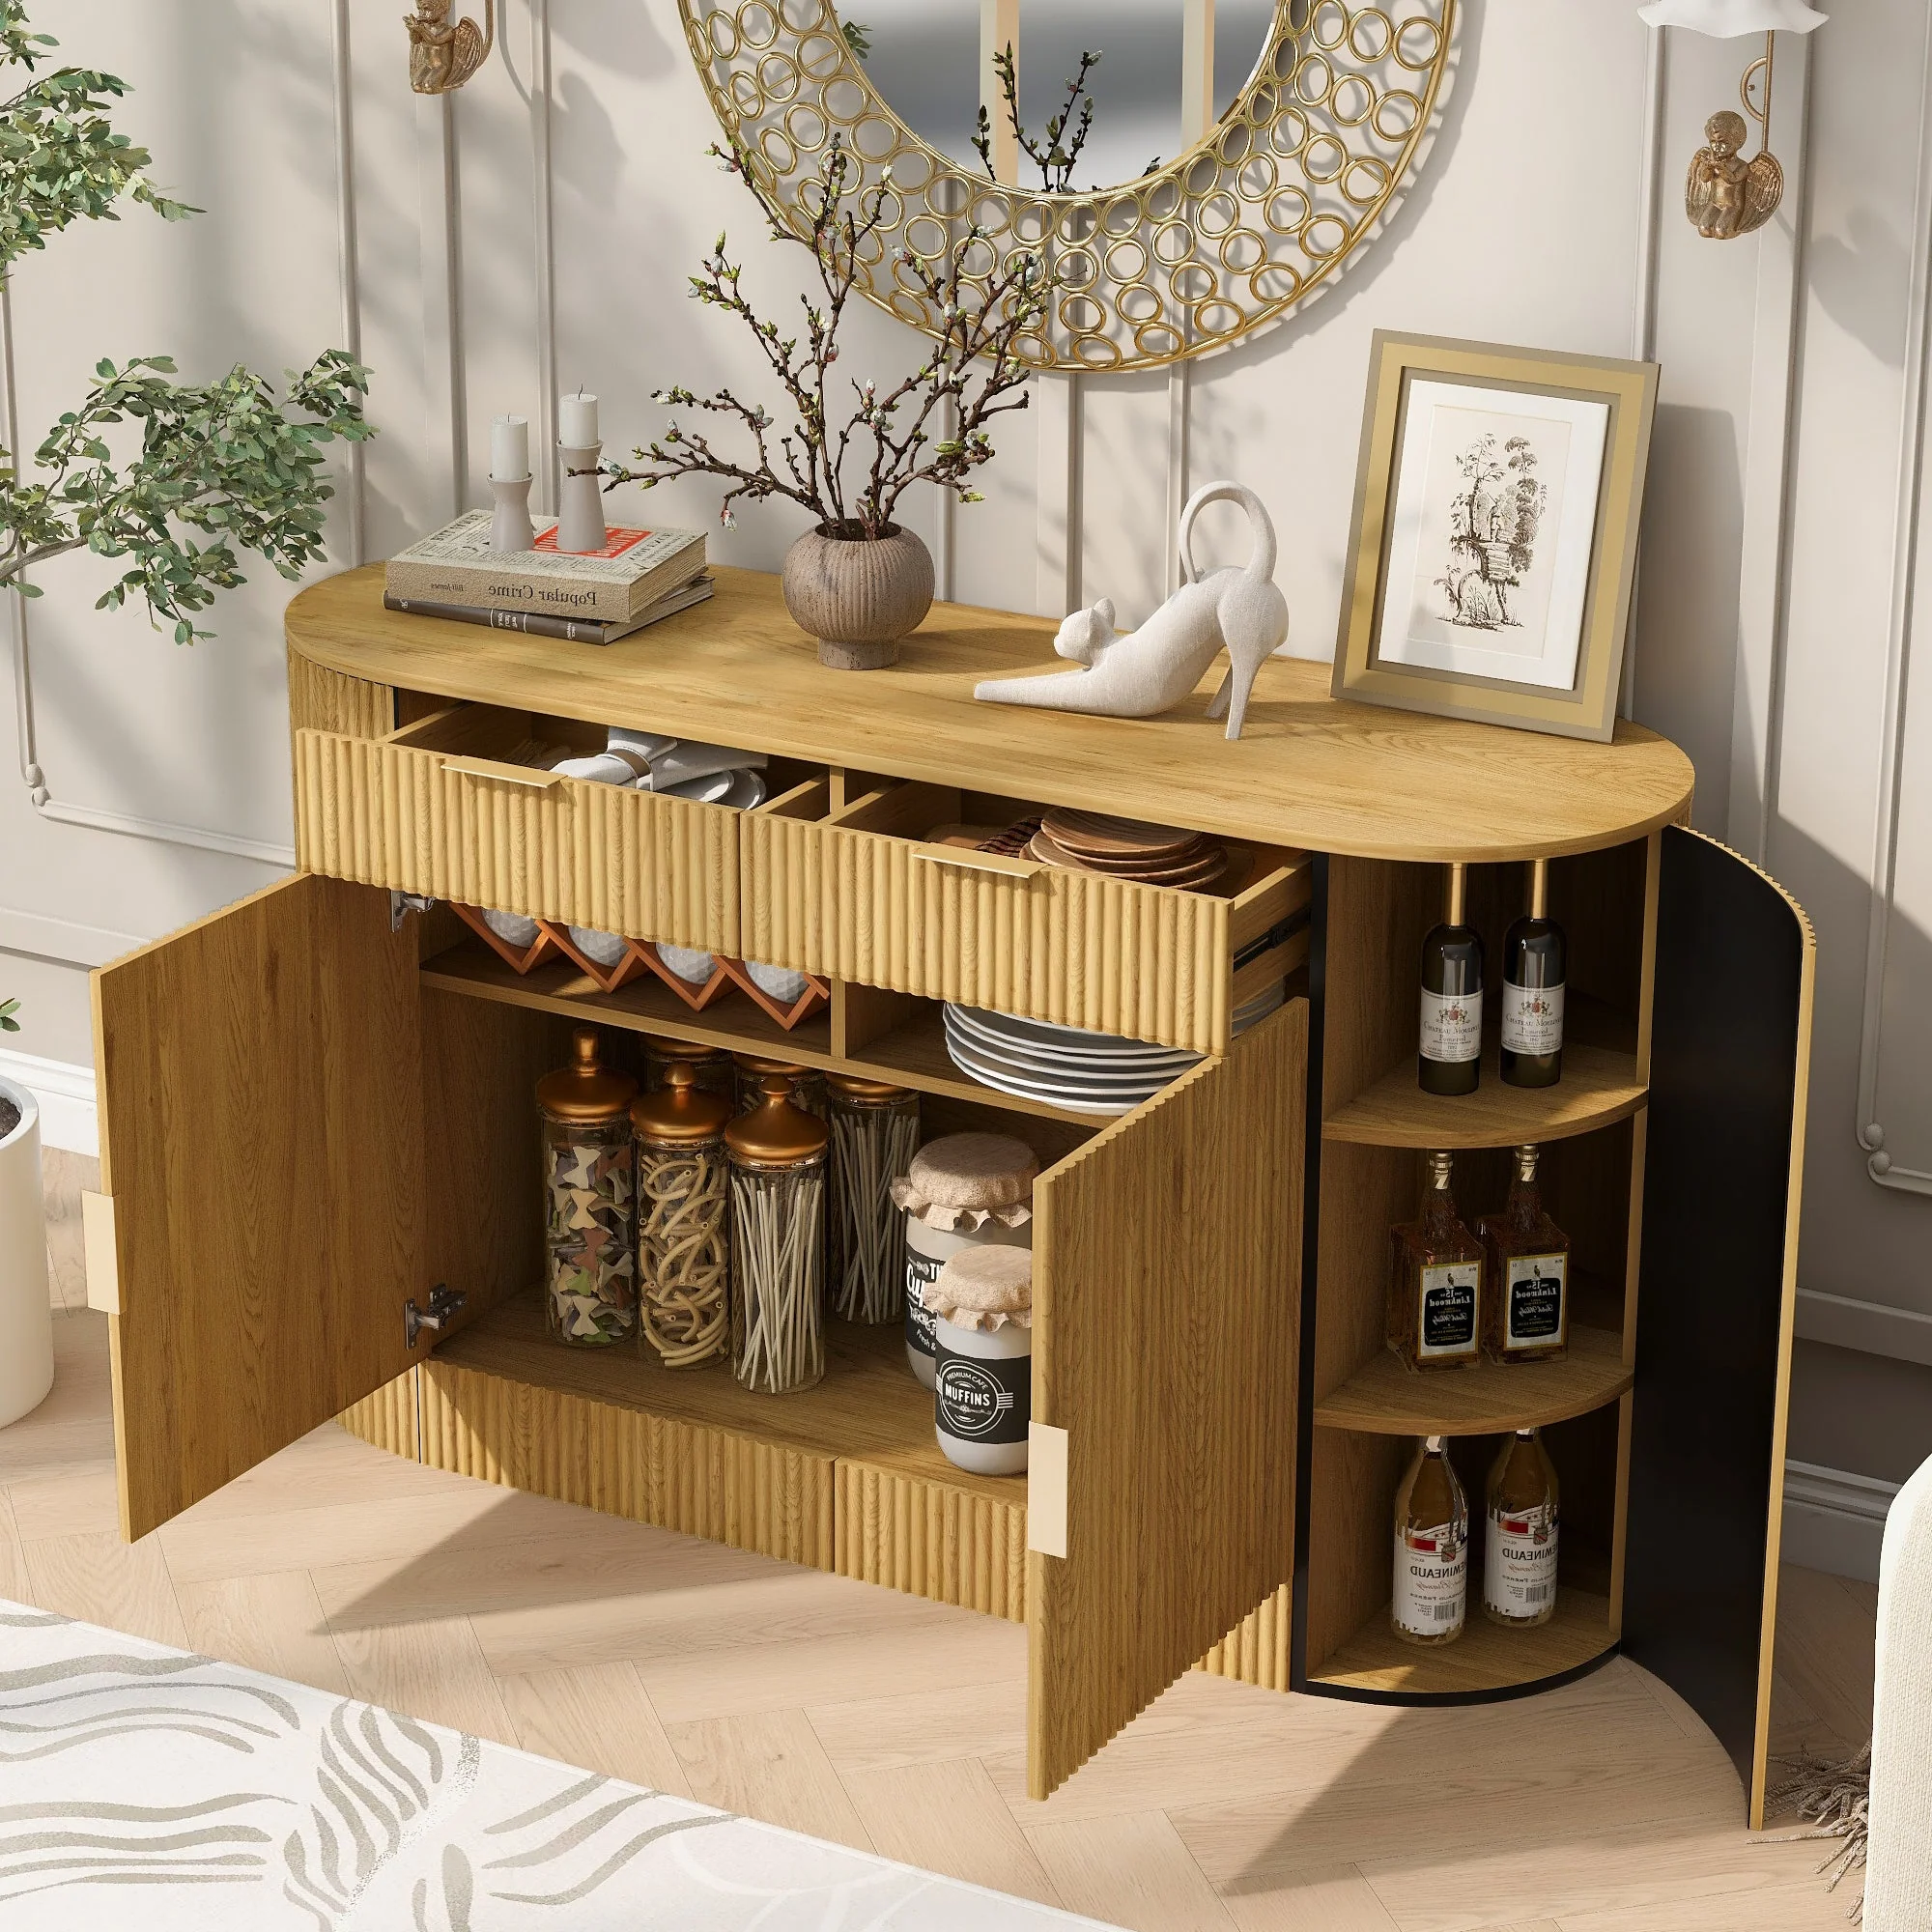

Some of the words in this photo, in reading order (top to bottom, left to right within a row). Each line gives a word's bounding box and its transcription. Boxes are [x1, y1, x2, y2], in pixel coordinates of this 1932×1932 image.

[946, 1371, 972, 1381] PREMIUM
[972, 1376, 989, 1390] CAFE
[945, 1382, 991, 1406] MUFFINS
